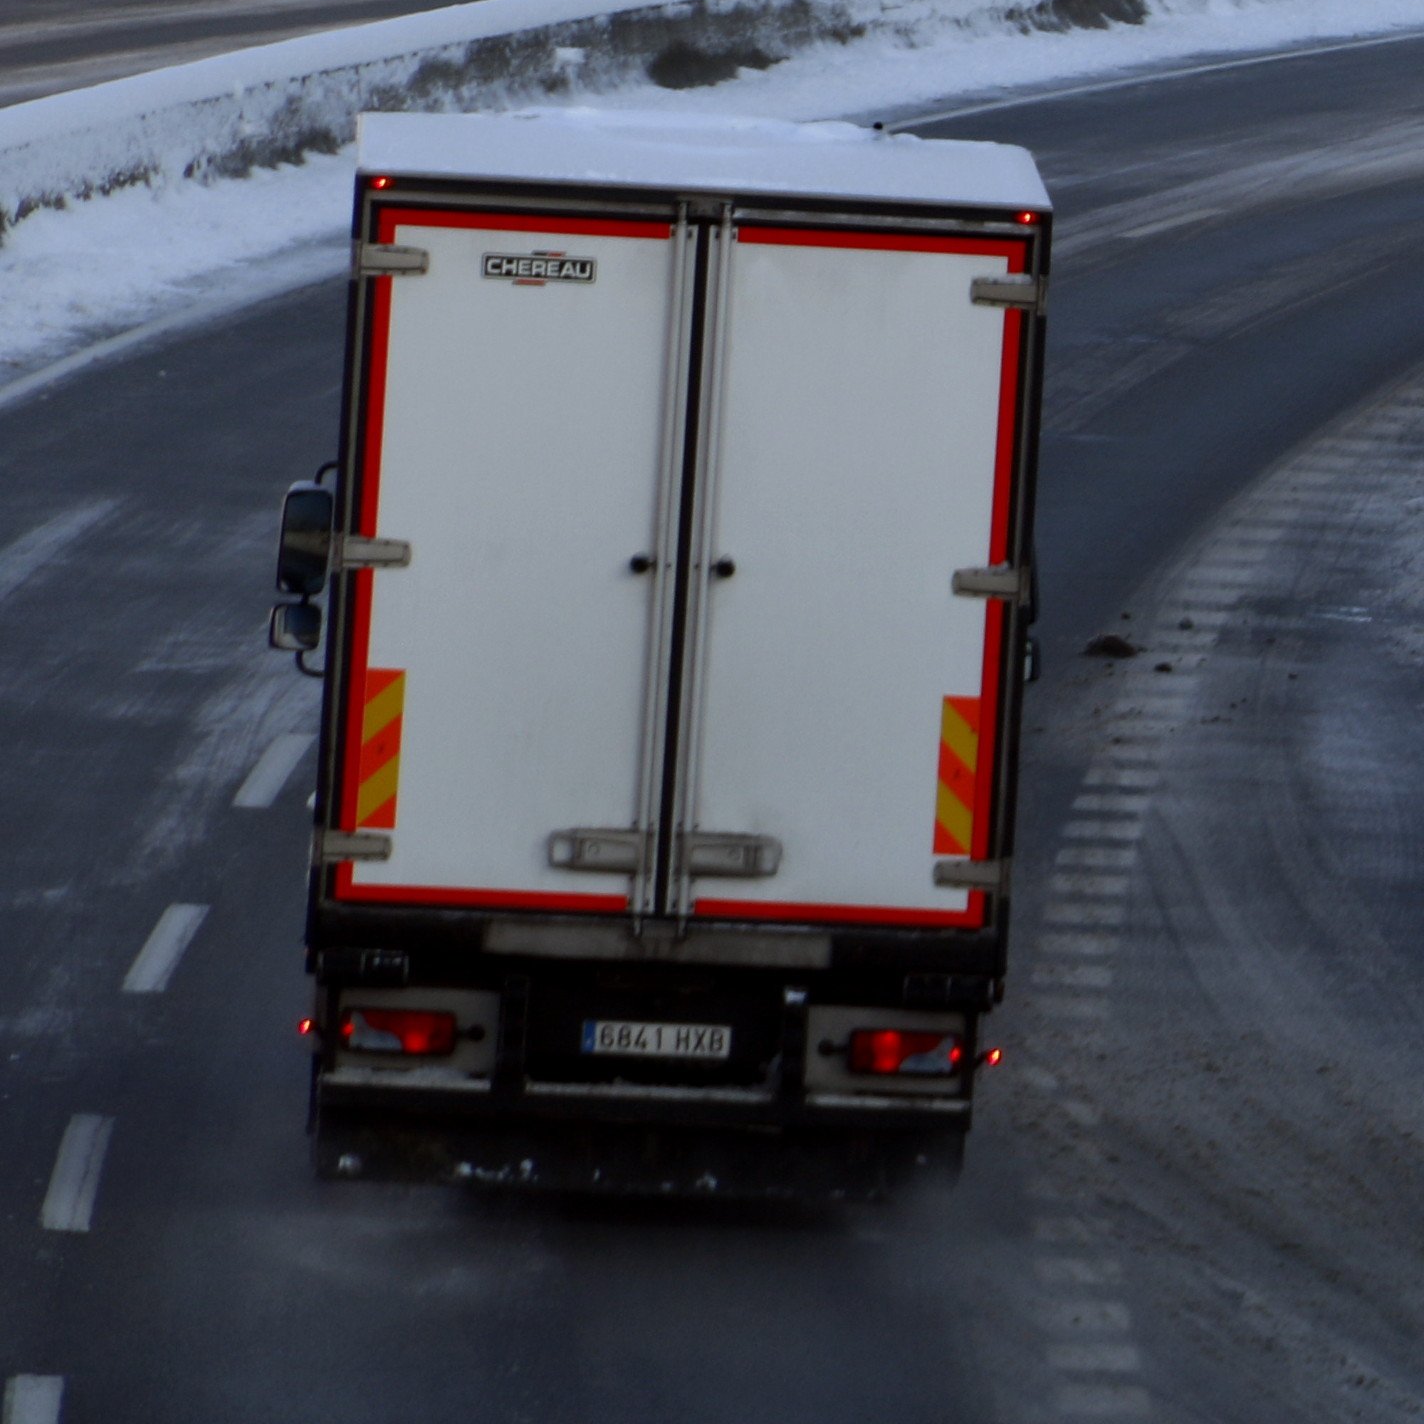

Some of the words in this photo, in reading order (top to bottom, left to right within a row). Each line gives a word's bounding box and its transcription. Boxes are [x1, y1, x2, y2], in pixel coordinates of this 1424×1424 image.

[486, 256, 593, 280] CHEREAU
[600, 1025, 663, 1050] 6841
[675, 1027, 724, 1054] HXB
